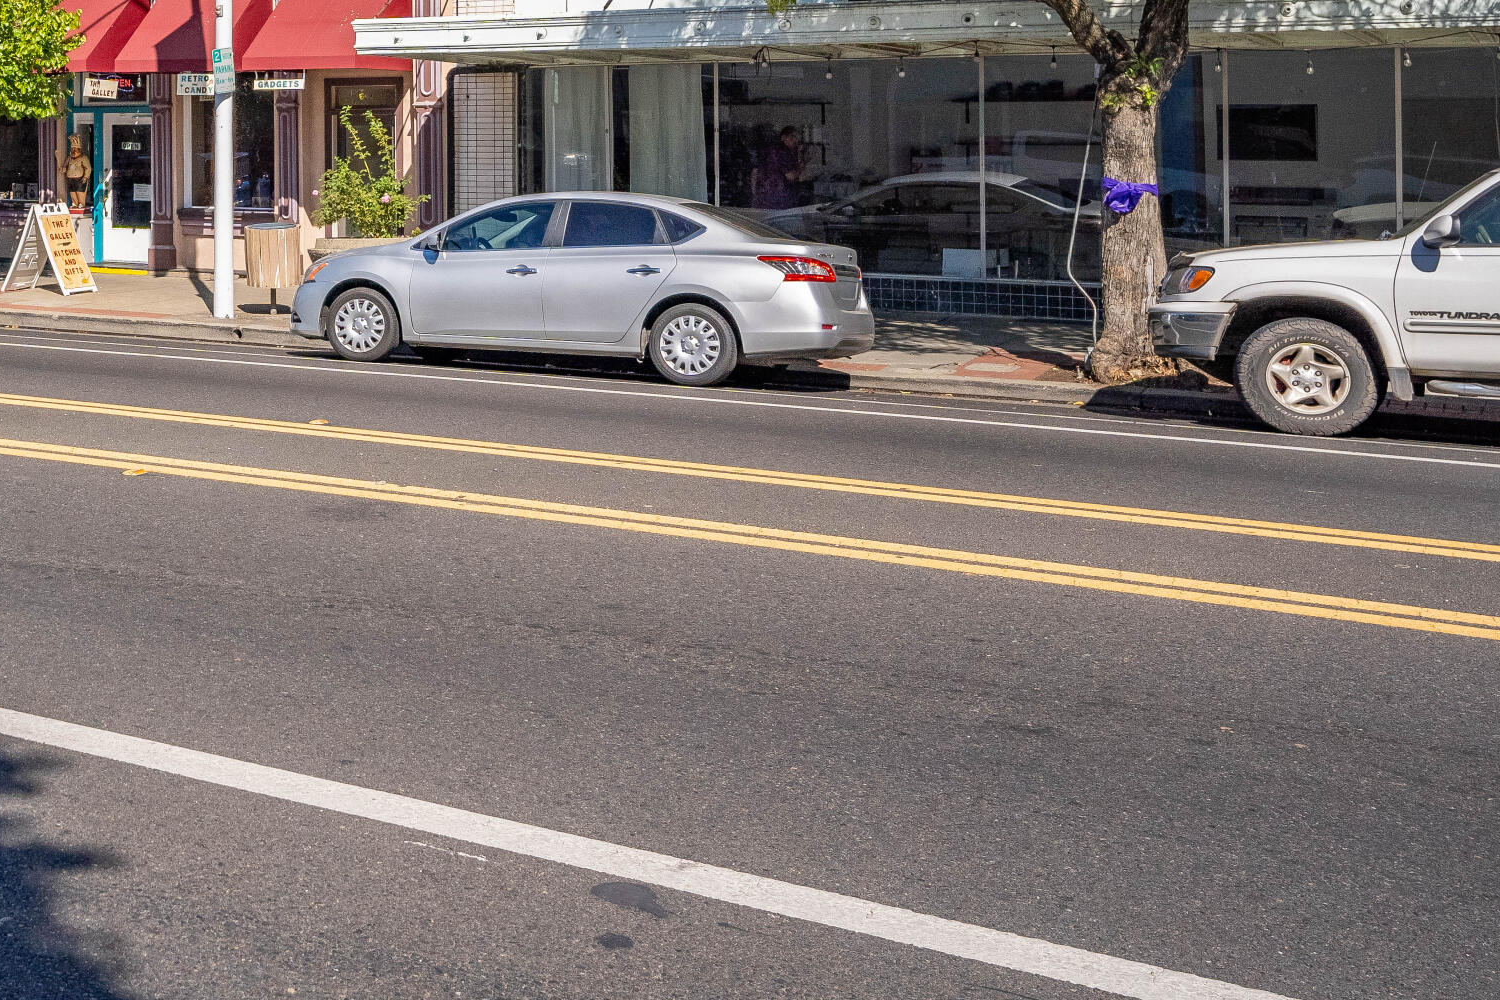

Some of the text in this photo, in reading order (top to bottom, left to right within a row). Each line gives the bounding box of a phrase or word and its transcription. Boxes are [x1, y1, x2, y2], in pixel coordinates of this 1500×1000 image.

[214, 51, 221, 61] 2
[181, 75, 210, 83] RETRO
[257, 80, 300, 89] GADGETS
[91, 88, 115, 97] GALLEY
[184, 86, 213, 94] CANDY
[52, 219, 65, 229] THE
[49, 232, 74, 241] GALLEY
[53, 247, 82, 258] KITCHEN
[64, 258, 77, 266] AND
[64, 266, 84, 276] GIFTS
[1436, 310, 1500, 320] TUNDRA
